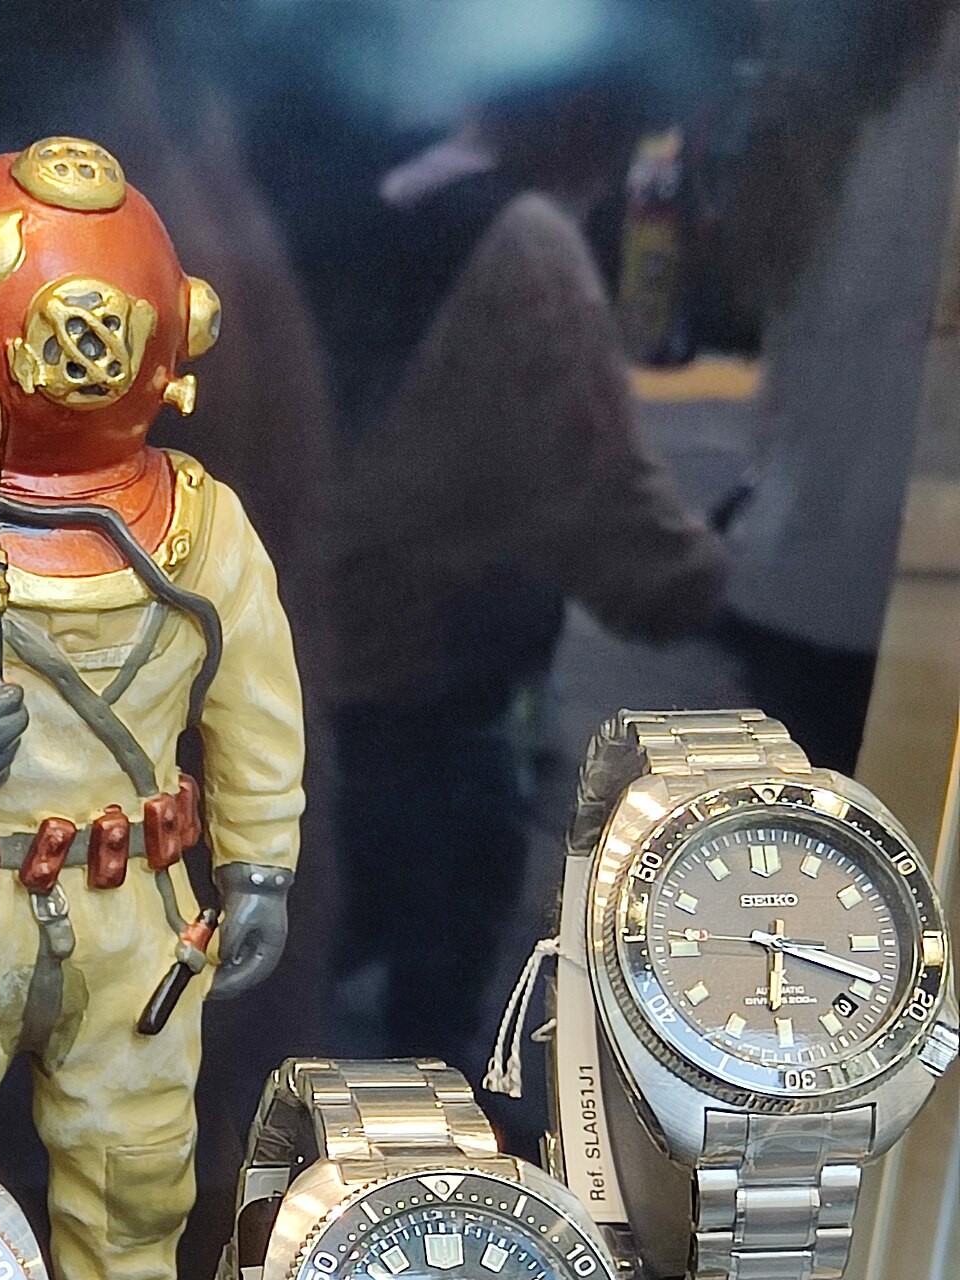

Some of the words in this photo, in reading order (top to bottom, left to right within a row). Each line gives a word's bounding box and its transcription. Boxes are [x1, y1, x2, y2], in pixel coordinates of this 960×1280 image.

[633, 851, 663, 882] 50
[891, 850, 918, 877] 10
[740, 893, 798, 907] SEIKO
[648, 994, 677, 1024] 40
[902, 987, 936, 1022] 20
[784, 1068, 817, 1090] 30
[578, 1064, 600, 1160] SLA051J1
[586, 1167, 607, 1201] Ref.
[565, 1243, 597, 1277] 10
